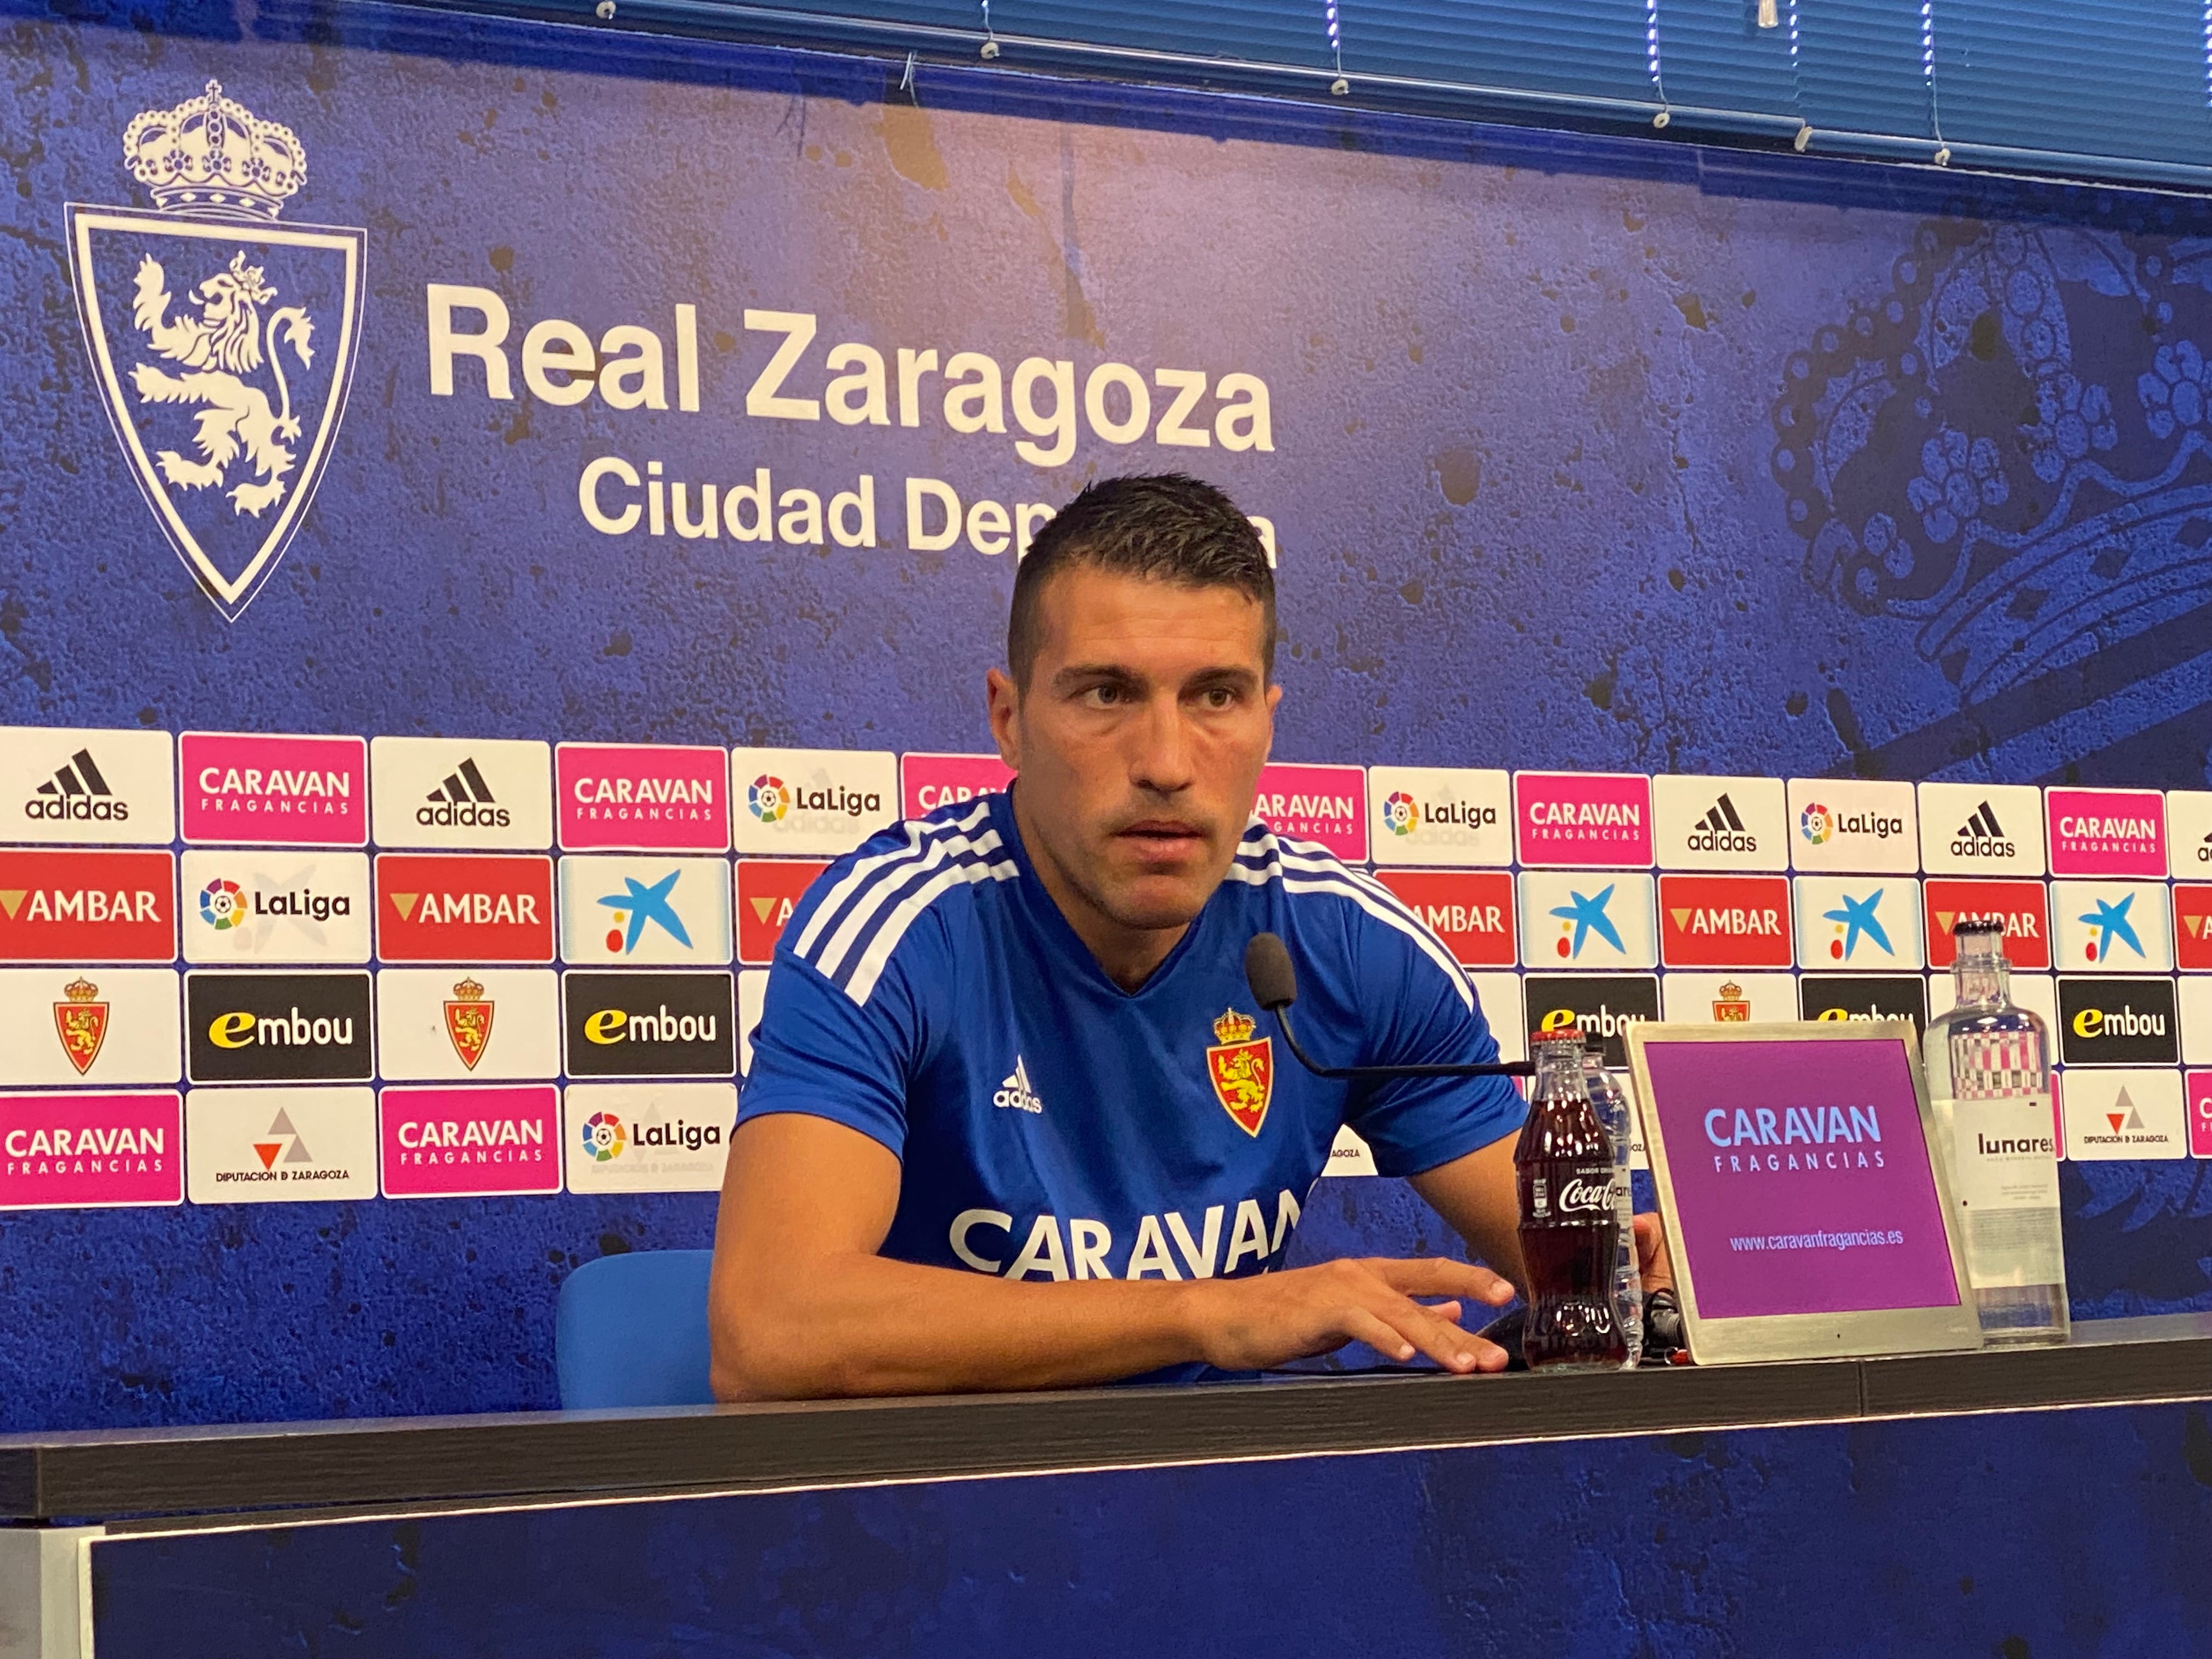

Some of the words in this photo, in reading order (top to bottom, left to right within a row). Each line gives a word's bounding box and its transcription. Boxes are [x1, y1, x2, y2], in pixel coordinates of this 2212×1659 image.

[427, 284, 699, 412] Real
[744, 309, 1275, 466] Zaragoza
[579, 457, 876, 547] Ciudad
[200, 768, 349, 798] CARAVAN
[575, 778, 712, 804] CARAVAN
[25, 795, 128, 820] adidas
[202, 798, 348, 815] FRAGANCIAS
[416, 801, 510, 827] adidas
[797, 786, 880, 816] LaLiga
[1250, 793, 1353, 820] ARAVAN
[1530, 802, 1639, 826] CARAVAN
[577, 808, 712, 821] FRAGANCIAS
[1274, 821, 1352, 834] GANCIAS
[1425, 800, 1496, 829] LaLiga
[1838, 812, 1903, 838] LaLiga
[2060, 816, 2156, 839] CARAVAN
[1532, 828, 1639, 840] FRAGANCIAS
[1688, 831, 1757, 852] adidas
[1951, 837, 2015, 857] adidas
[2062, 841, 2155, 853] FRAGANCIAS
[27, 890, 161, 922] AMBAR
[255, 889, 350, 921] LaLiga
[419, 894, 540, 924] AMBAR
[1692, 909, 1781, 935] AMBAR
[208, 1007, 353, 1048] embou
[585, 1005, 716, 1045] embou
[2073, 1005, 2165, 1038] embou
[398, 1119, 543, 1149] CARAVAN
[633, 1120, 720, 1151] LaLiga
[1705, 1106, 1881, 1147] CARAVAN
[2132, 1135, 2169, 1143] ZARAGOZA
[5, 1128, 163, 1157] CARAVAN
[1331, 1149, 1360, 1158] AGOZA
[8, 1159, 162, 1176] FRAGANCIAS
[401, 1149, 542, 1165] FRAGANCIAS
[1714, 1150, 1884, 1172] FRAGANCIAS
[292, 1170, 350, 1181] ZARAGOZA
[1730, 1229, 1904, 1251] www.caravanfragancias.es
